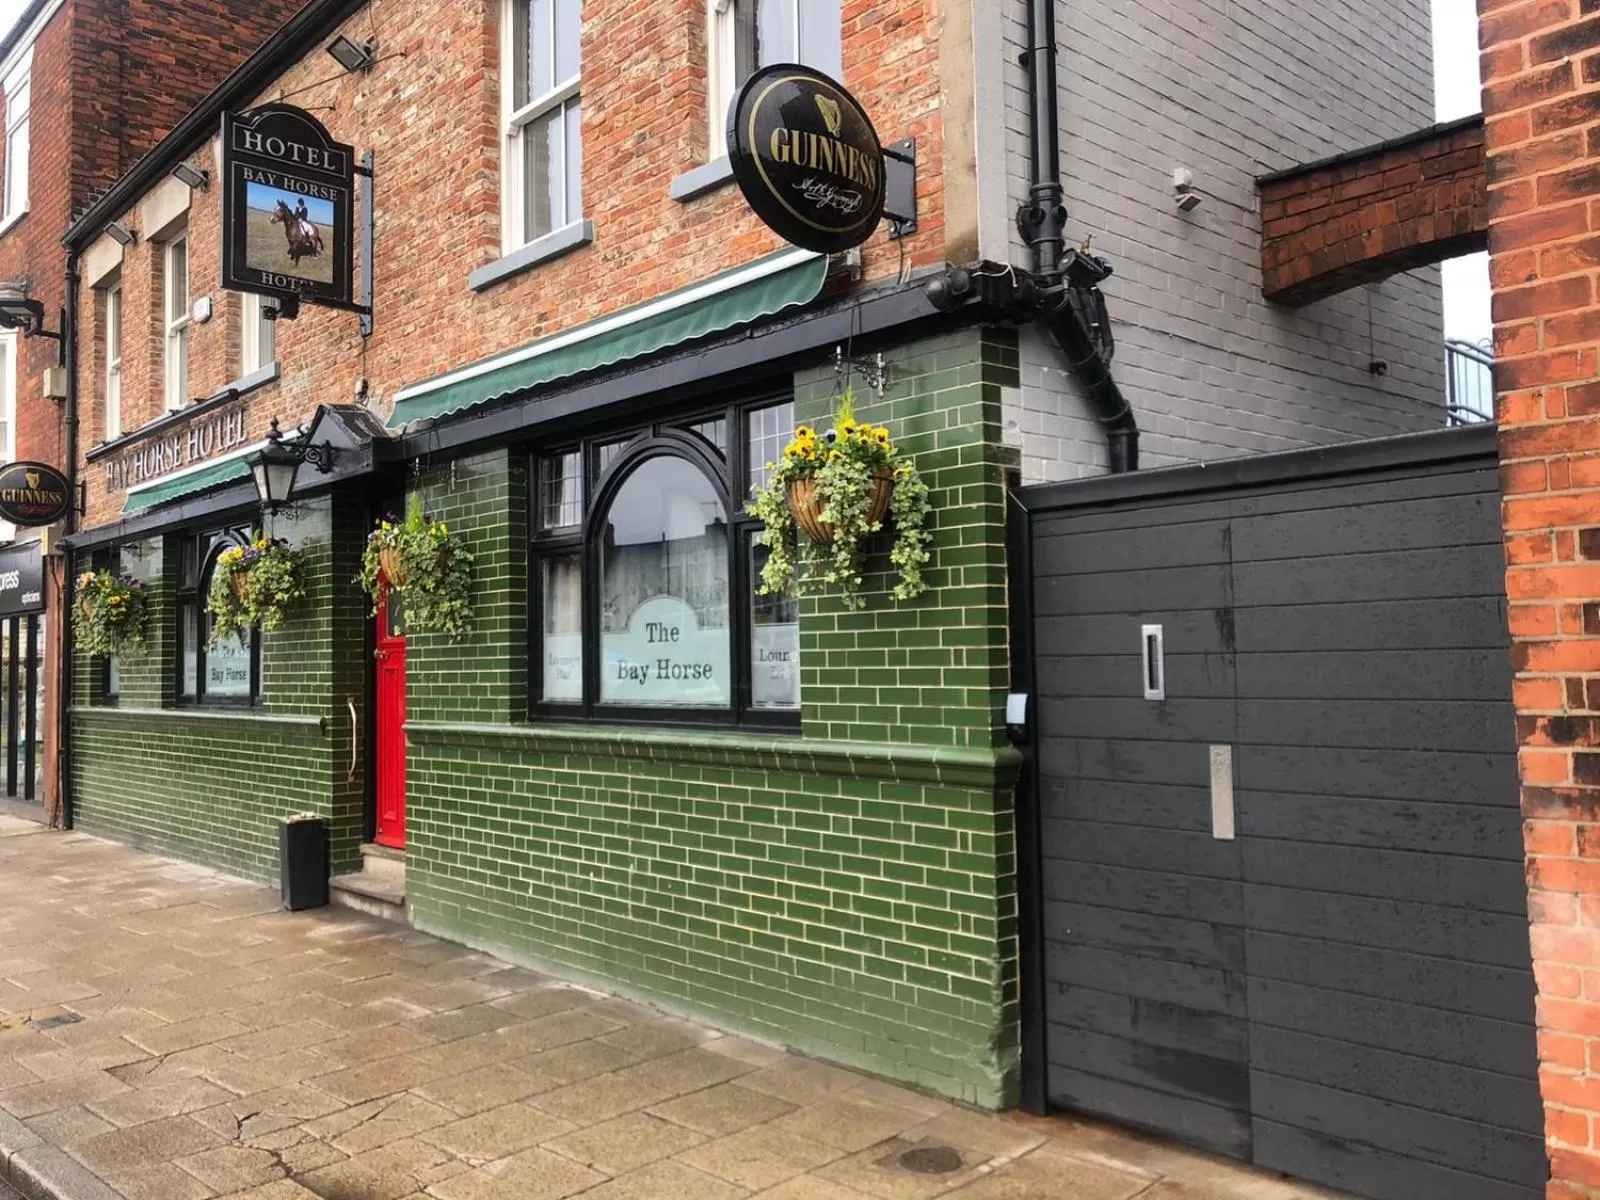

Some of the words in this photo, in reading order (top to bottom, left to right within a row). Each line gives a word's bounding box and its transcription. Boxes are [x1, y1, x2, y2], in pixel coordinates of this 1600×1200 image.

[243, 129, 335, 169] HOTEL
[770, 127, 876, 192] GUINNESS
[243, 167, 277, 186] BAY
[283, 177, 338, 201] HORSE
[105, 459, 129, 492] BAY
[133, 437, 182, 482] HORSE
[187, 408, 247, 462] HOTEL
[2, 488, 63, 504] GUINNESS
[645, 622, 681, 643] The
[617, 660, 650, 685] Bay
[656, 658, 713, 680] Horse
